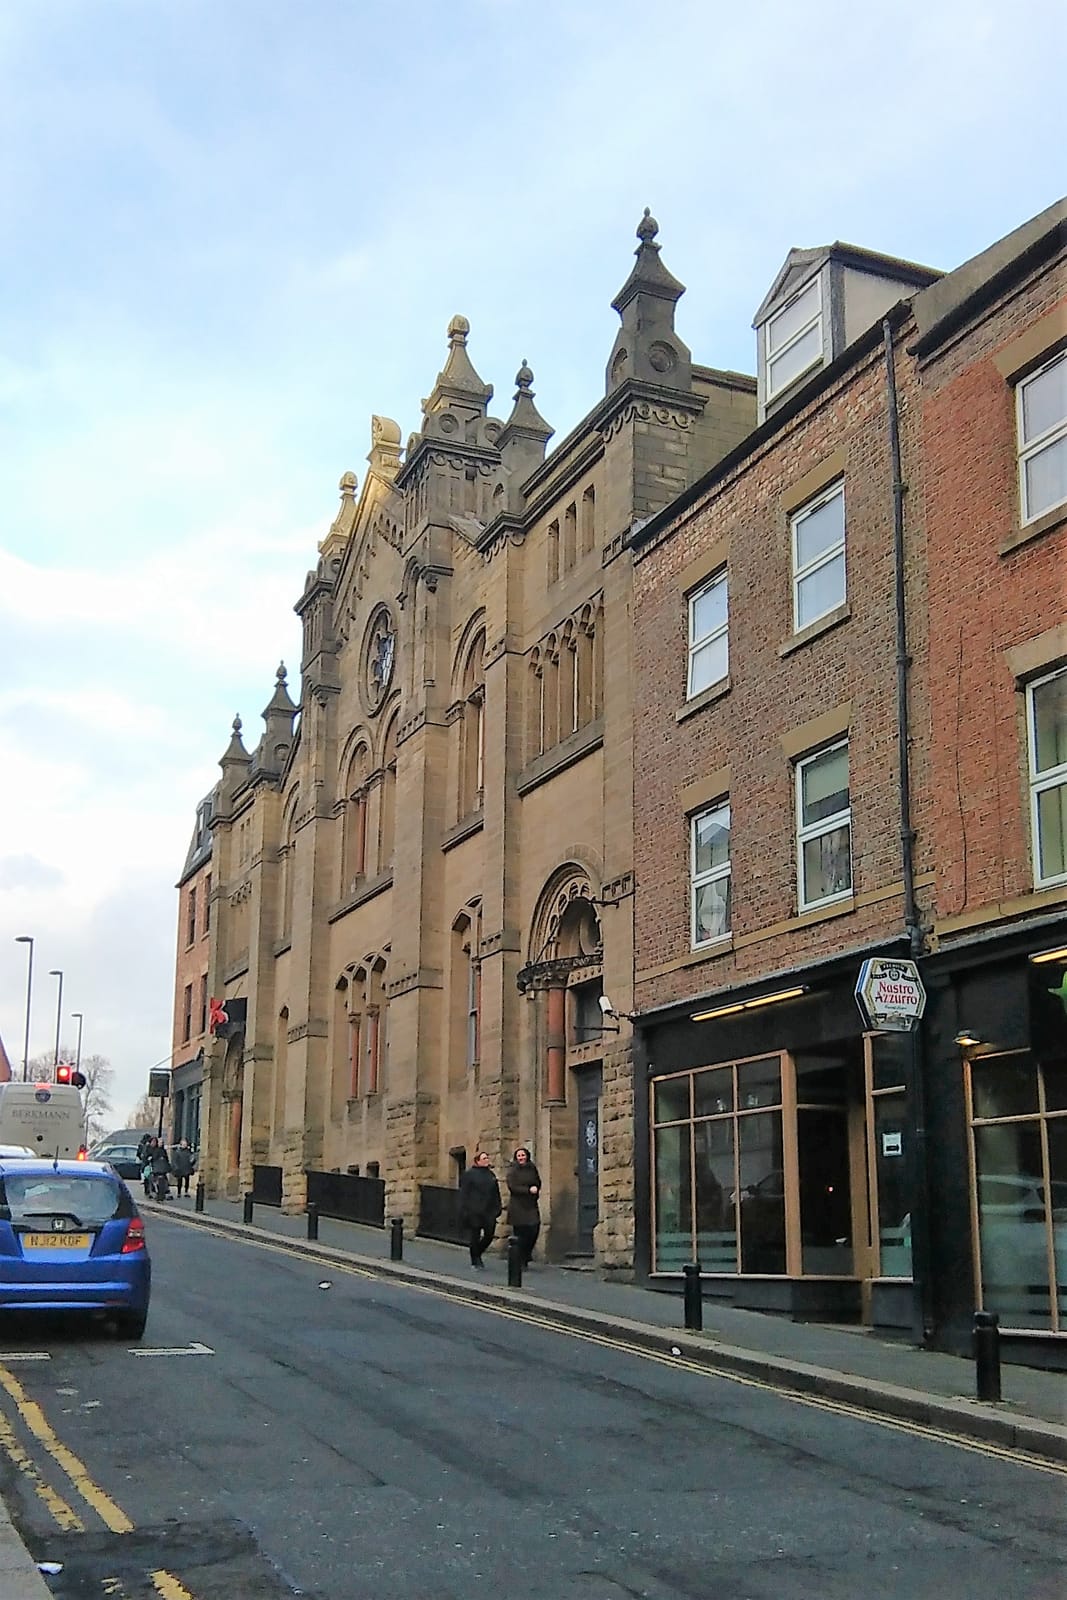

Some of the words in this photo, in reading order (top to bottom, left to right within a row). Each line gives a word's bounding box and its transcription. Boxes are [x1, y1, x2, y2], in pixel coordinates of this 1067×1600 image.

[879, 981, 914, 995] Nastro
[875, 992, 918, 1005] Azzurro
[12, 1109, 70, 1120] BERKMANN
